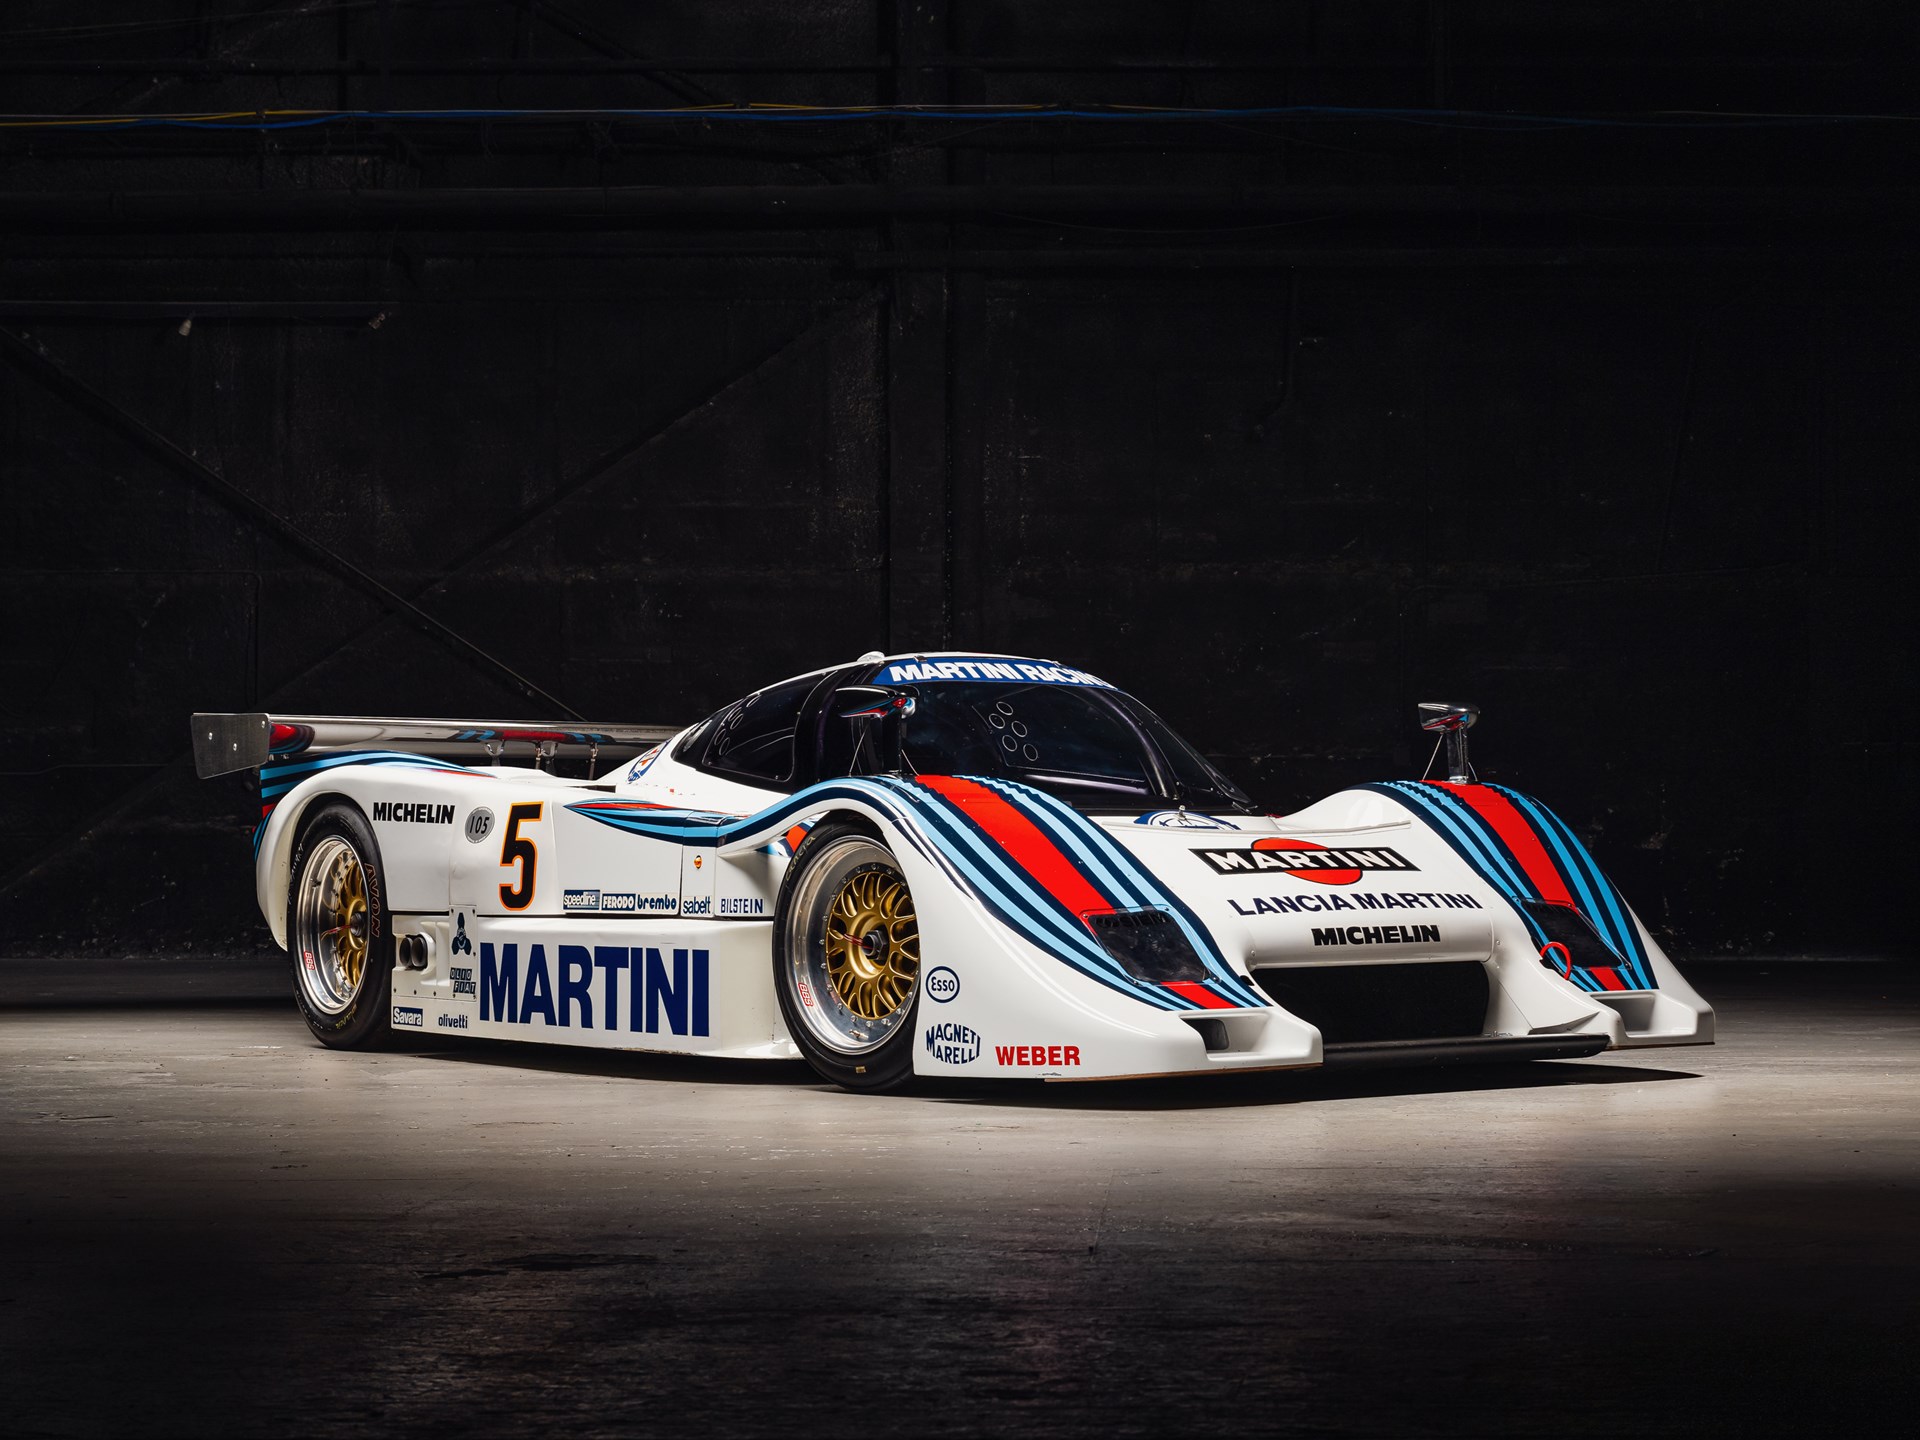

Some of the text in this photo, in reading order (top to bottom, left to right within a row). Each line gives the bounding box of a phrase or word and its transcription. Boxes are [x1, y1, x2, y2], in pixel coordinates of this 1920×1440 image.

[888, 662, 1024, 682] MARTINI
[373, 802, 455, 824] MICHELIN
[469, 815, 490, 834] 105
[499, 801, 544, 911] 5
[1204, 850, 1407, 871] MARTINI
[364, 863, 380, 938] AVON
[563, 891, 596, 906] speedline
[602, 895, 635, 909] FERODO
[637, 893, 677, 910] brembo
[683, 896, 711, 914] sabelt
[720, 898, 763, 914] BILSTEIN
[1227, 892, 1483, 916] LANCIA MARTINI
[1311, 924, 1441, 946] MICHELIN
[450, 968, 472, 980] OLIO
[454, 981, 476, 994] FIAT
[479, 942, 710, 1037] MARTINI
[799, 983, 814, 1006] BBS
[393, 1007, 422, 1026] Savara
[438, 1013, 468, 1029] olivetti
[926, 1023, 981, 1053] MAGNETI
[926, 1034, 980, 1064] MARELLI
[995, 1045, 1081, 1066] WEBER
